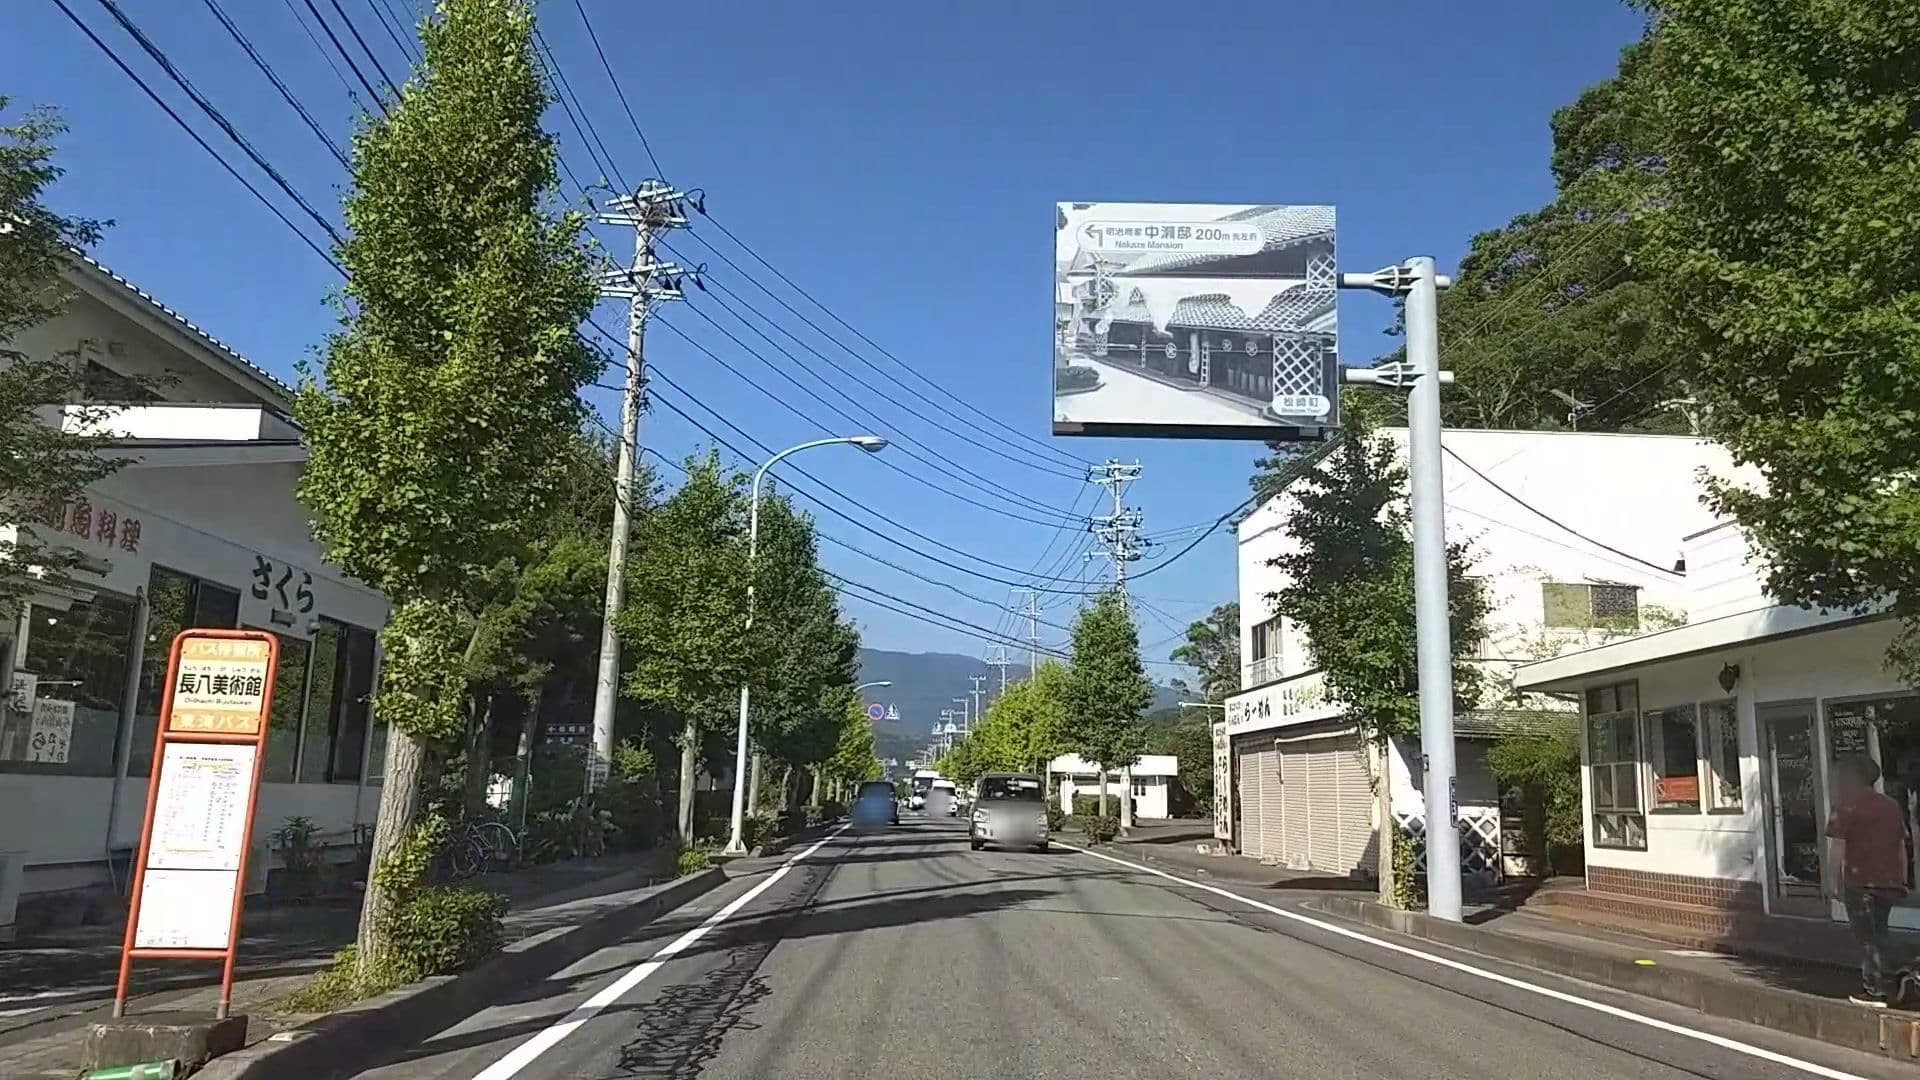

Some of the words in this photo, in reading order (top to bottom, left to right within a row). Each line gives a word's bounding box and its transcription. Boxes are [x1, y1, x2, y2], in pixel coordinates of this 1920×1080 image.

[1148, 241, 1184, 249] Mansion
[1196, 229, 1230, 240] 200m
[252, 555, 314, 613] さくら
[178, 673, 263, 697] 長八美術館
[1244, 696, 1271, 722] らーめん
